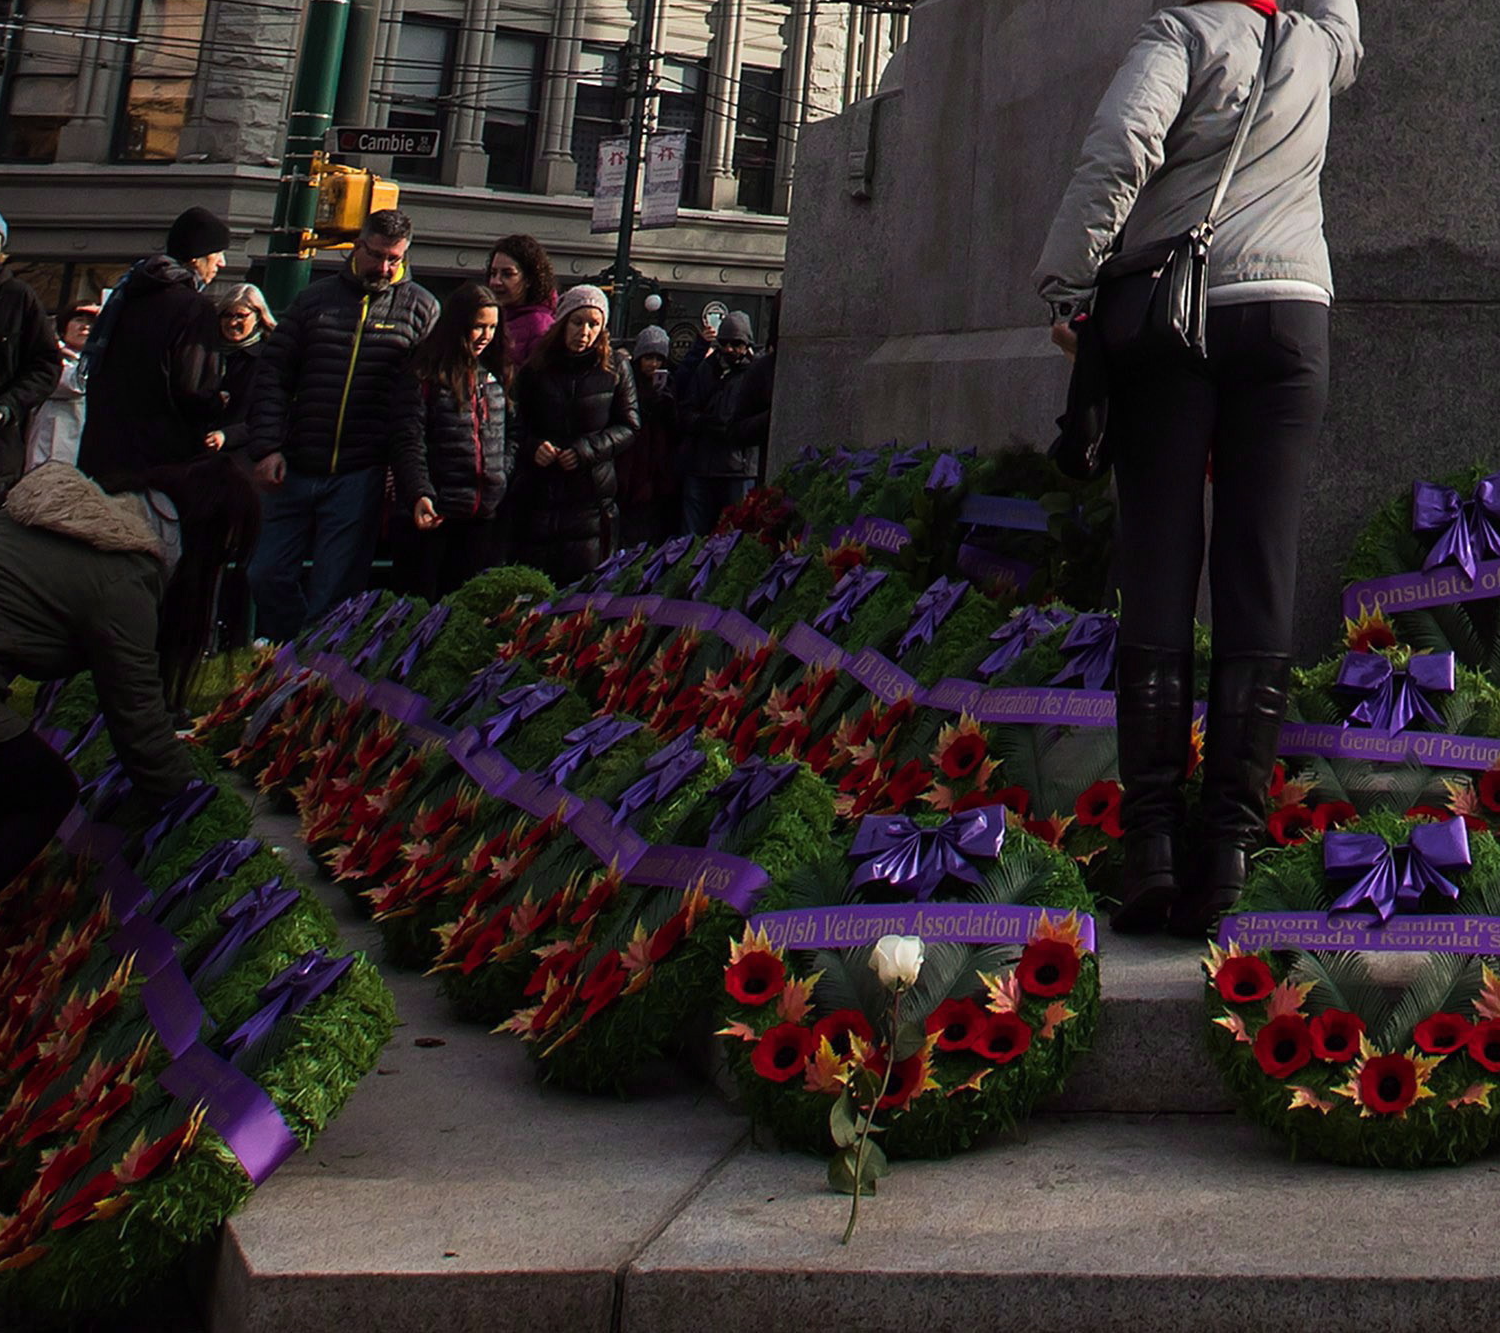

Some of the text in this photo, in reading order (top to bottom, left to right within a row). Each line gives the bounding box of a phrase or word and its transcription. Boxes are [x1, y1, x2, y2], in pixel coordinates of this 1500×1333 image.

[358, 133, 415, 152] Cambie
[862, 521, 908, 550] Mothe
[1357, 576, 1474, 610] Consulate
[1339, 730, 1409, 753] General
[1414, 736, 1434, 755] Of
[823, 914, 906, 942] Veterans
[911, 910, 1021, 939] Association
[1235, 916, 1323, 933] Slavom
[1235, 931, 1355, 947] Ambasada
[1380, 933, 1482, 948] Konzulat
